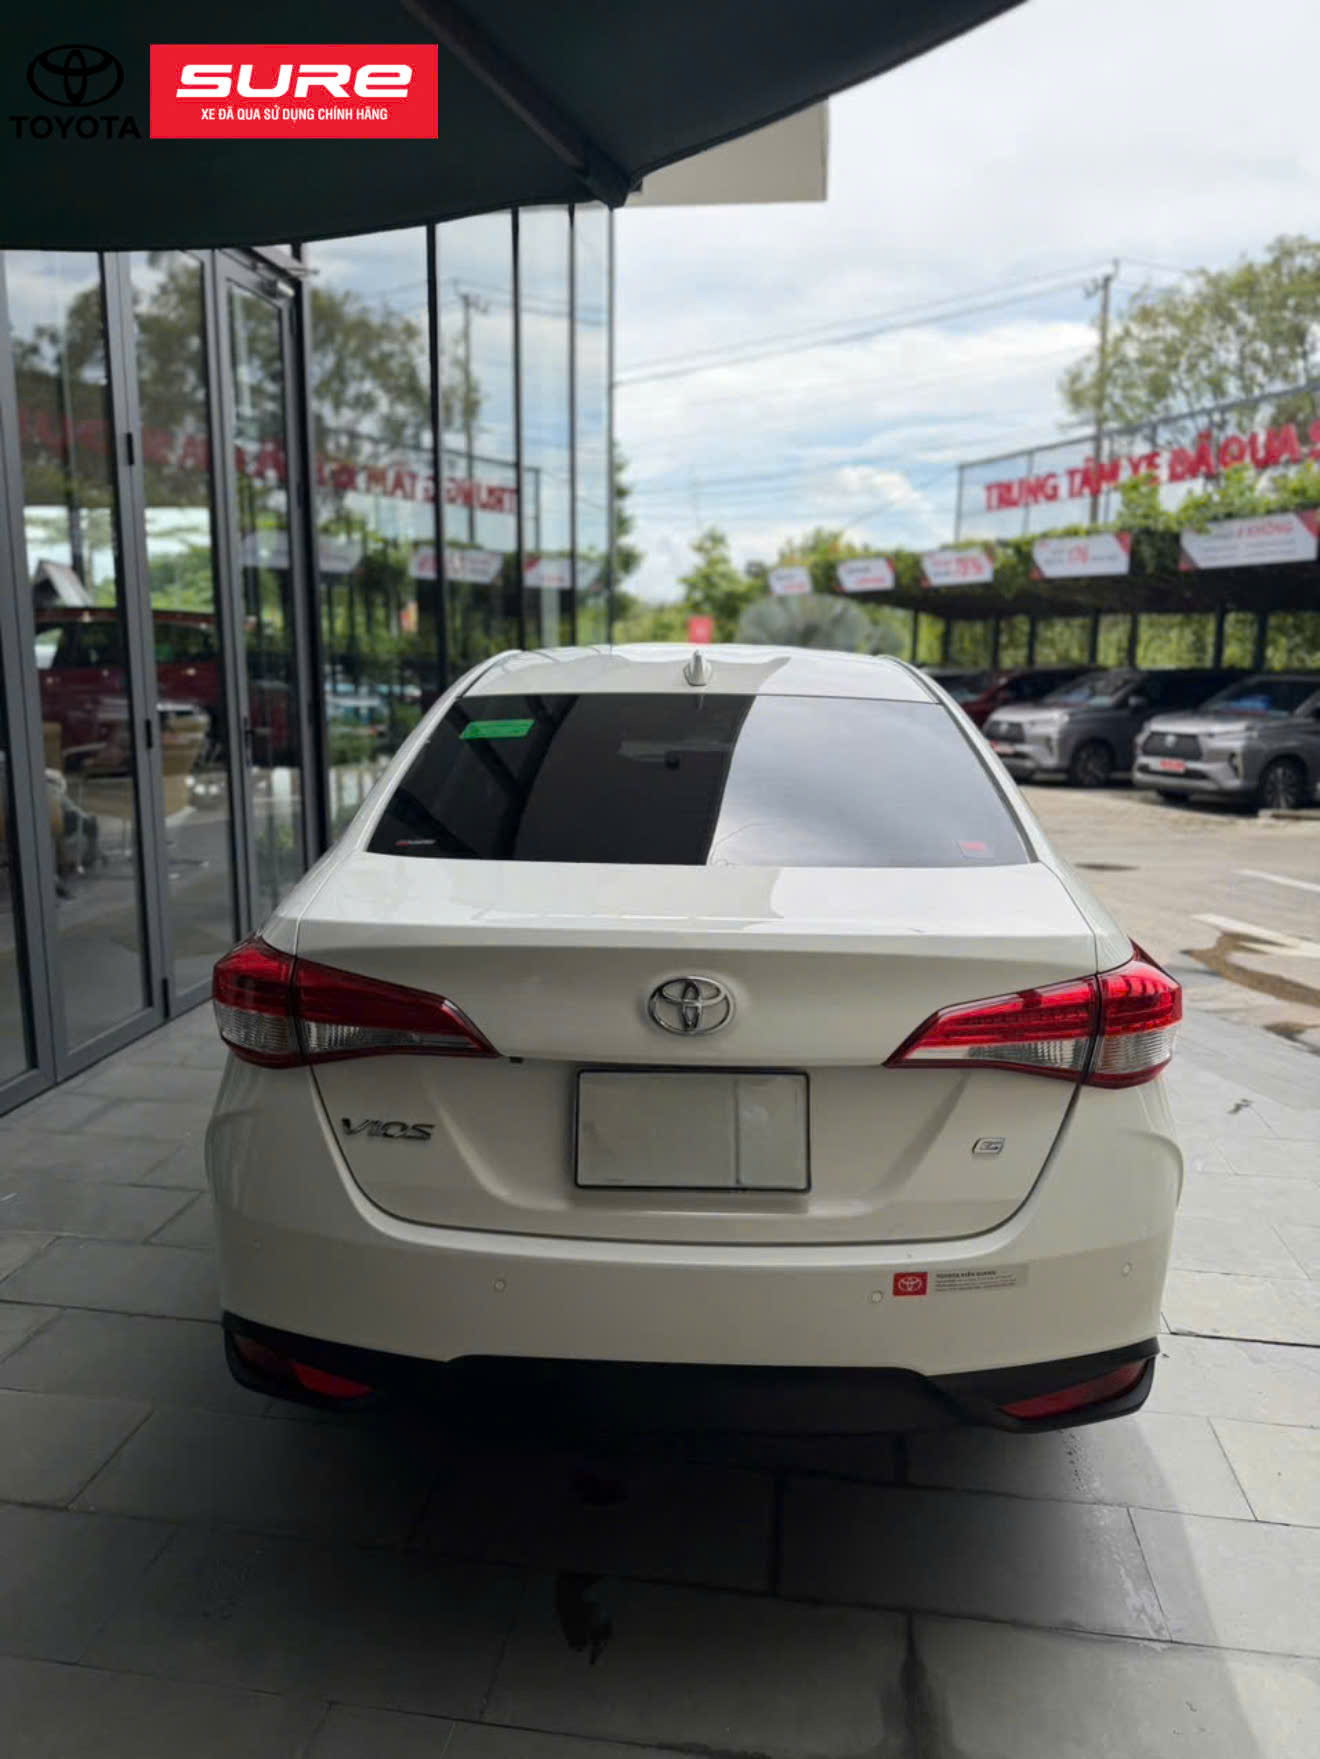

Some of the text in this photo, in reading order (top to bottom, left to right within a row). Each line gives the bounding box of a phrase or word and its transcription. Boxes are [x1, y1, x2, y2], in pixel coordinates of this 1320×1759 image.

[985, 471, 1059, 512] TRUNG
[1218, 422, 1300, 471] QUA
[341, 1118, 435, 1140] VIOS
